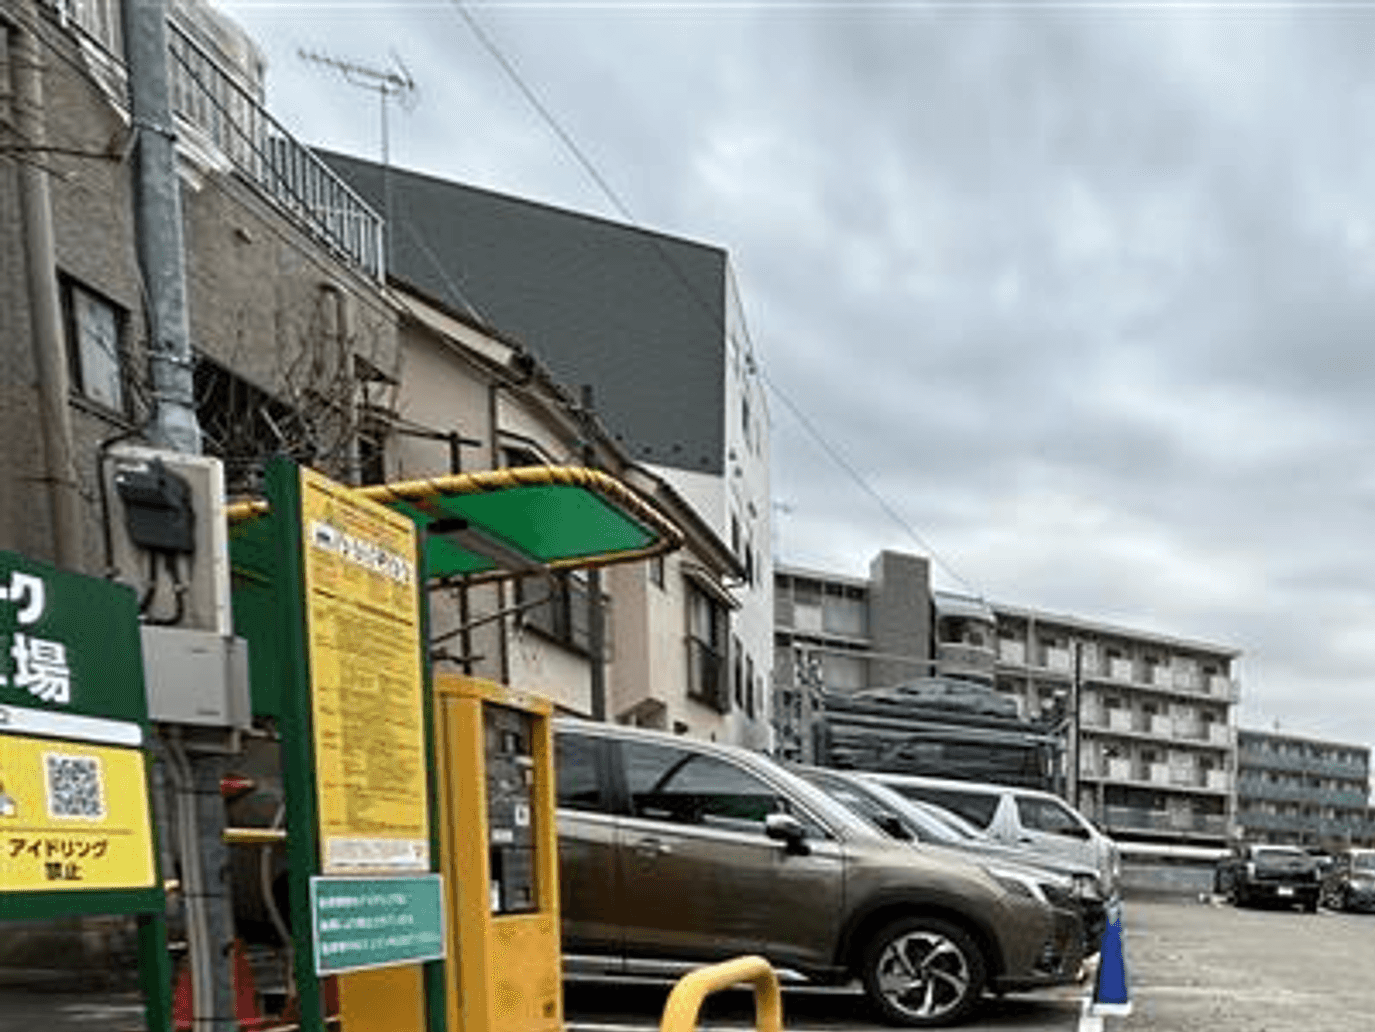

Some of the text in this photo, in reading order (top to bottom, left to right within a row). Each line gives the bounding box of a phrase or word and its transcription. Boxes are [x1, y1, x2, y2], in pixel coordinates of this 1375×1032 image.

[0, 571, 46, 624] ク
[0, 634, 70, 703] 場
[8, 838, 109, 859] アイドリング
